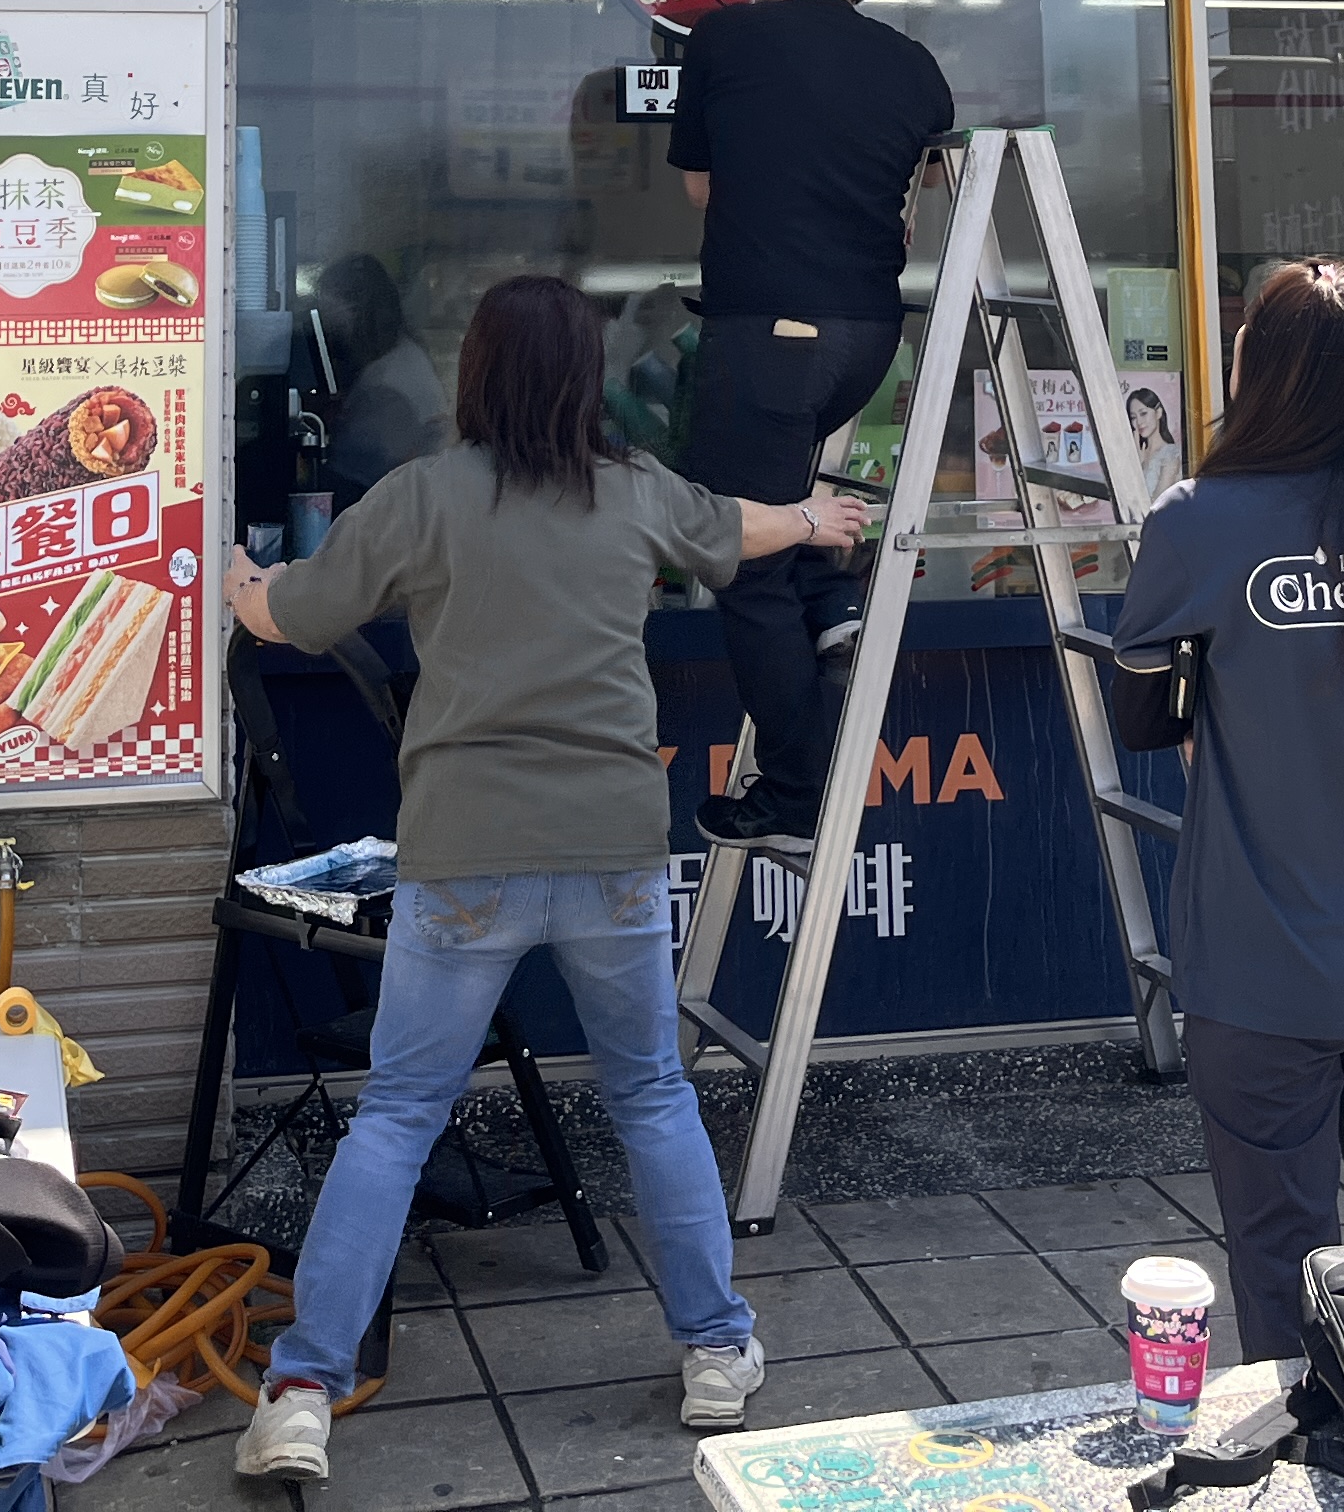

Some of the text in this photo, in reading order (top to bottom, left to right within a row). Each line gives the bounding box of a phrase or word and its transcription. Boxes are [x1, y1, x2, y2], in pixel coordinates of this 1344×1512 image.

[80, 72, 109, 104] 真
[130, 91, 160, 120] 好
[87, 553, 120, 570] DAY
